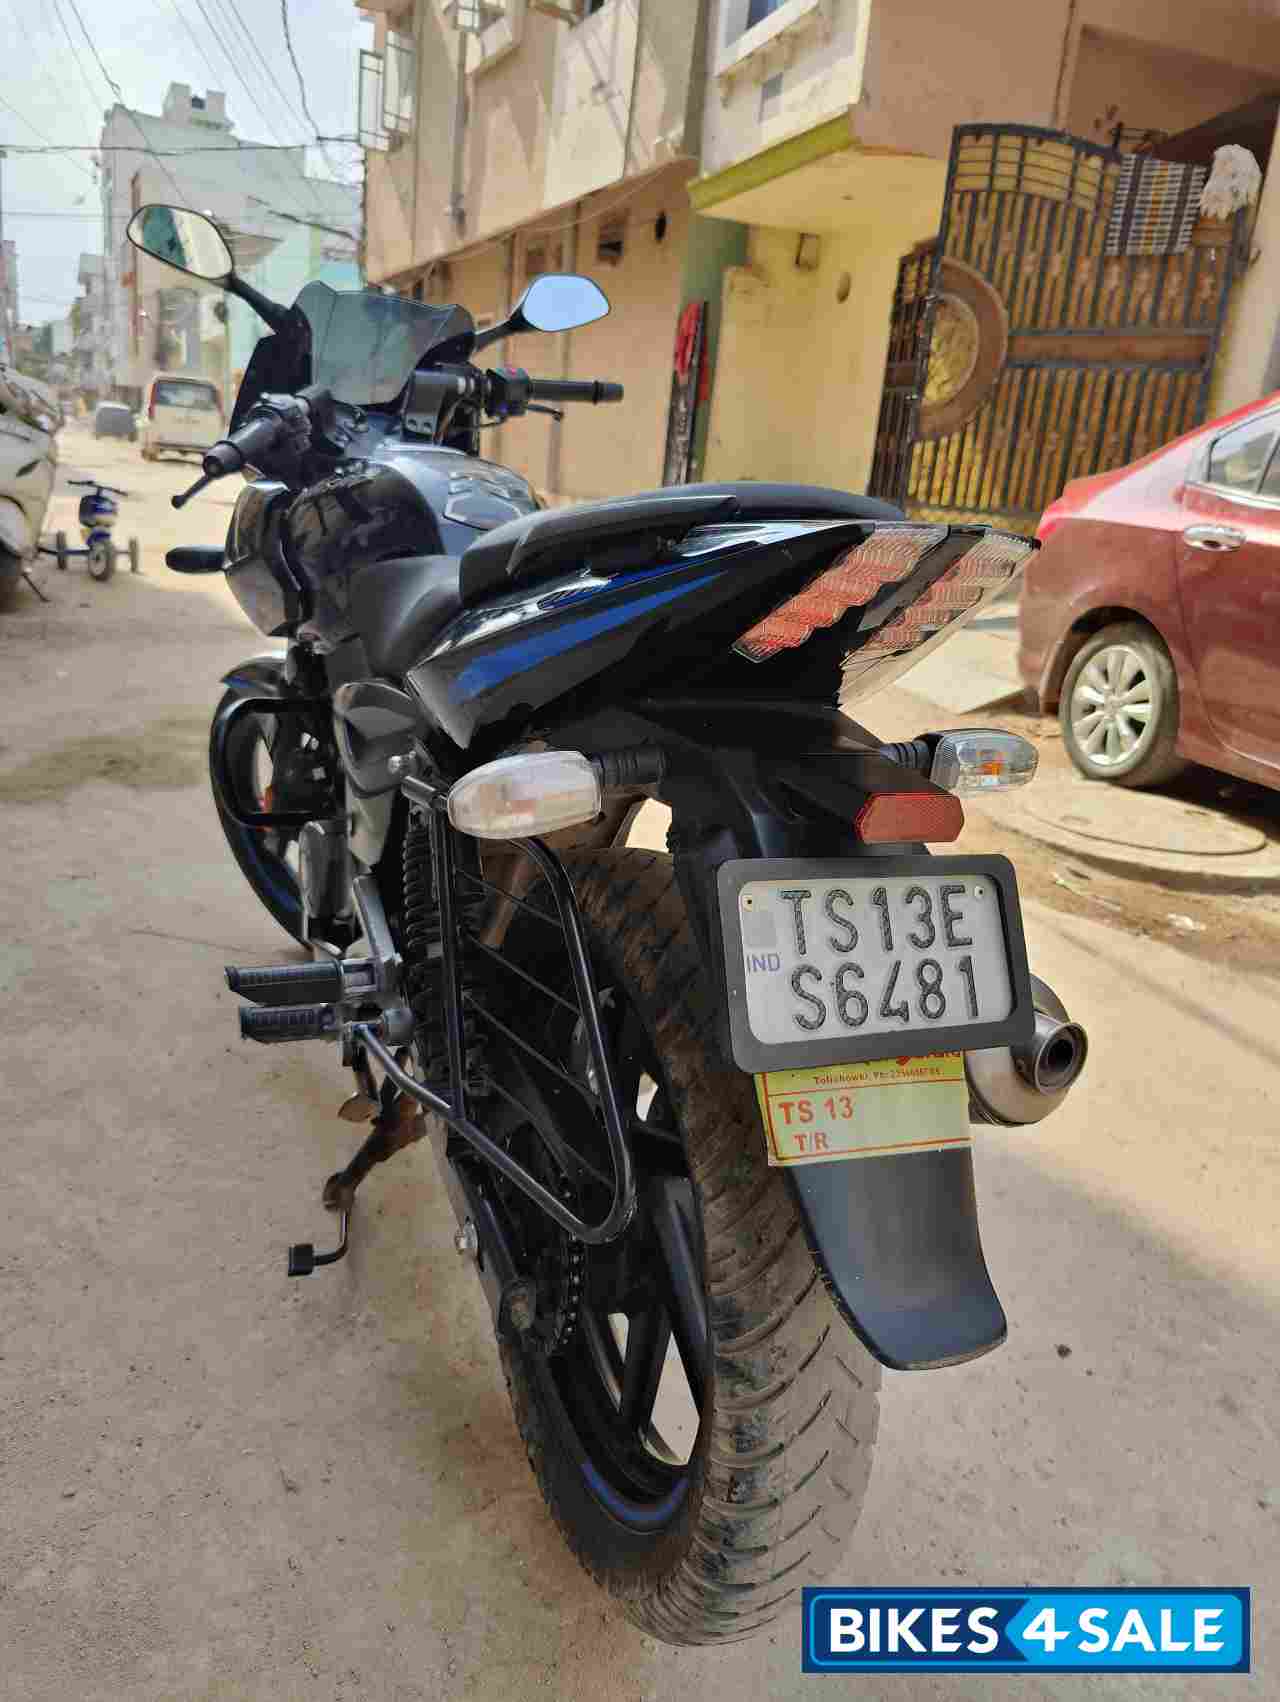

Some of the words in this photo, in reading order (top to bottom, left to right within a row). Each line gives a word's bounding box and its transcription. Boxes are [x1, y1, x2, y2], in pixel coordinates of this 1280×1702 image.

[779, 885, 973, 955] TS13E
[747, 954, 781, 972] IND
[791, 955, 979, 1031] S6481
[778, 1099, 814, 1125] TS
[823, 1096, 854, 1120] 13
